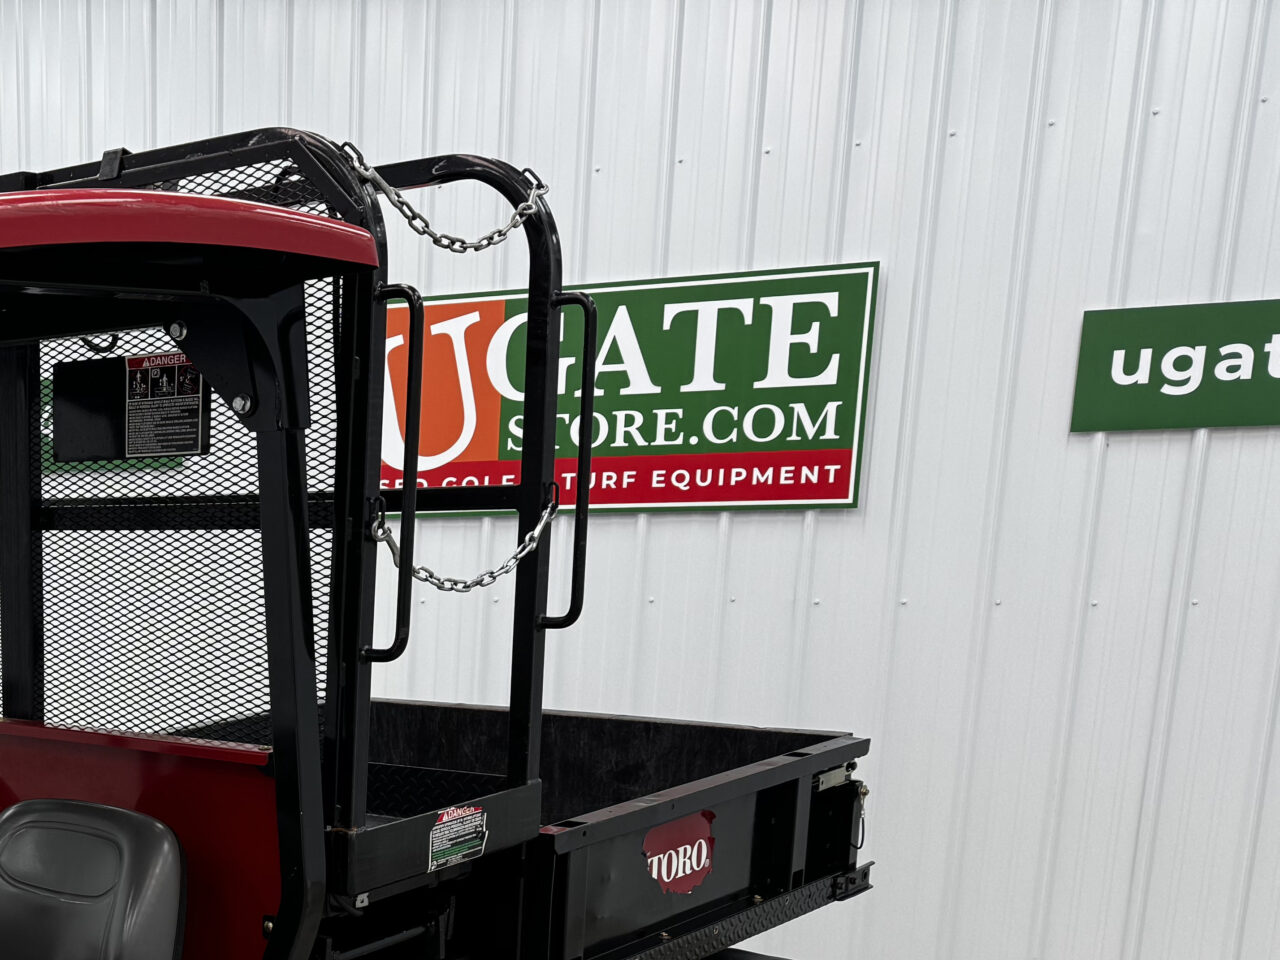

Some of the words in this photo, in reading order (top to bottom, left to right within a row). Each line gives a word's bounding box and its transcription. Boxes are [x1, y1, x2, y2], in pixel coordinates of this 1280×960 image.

[150, 354, 187, 366] DANGER
[651, 464, 842, 488] EQUIPMENT
[647, 839, 708, 882] TORO
